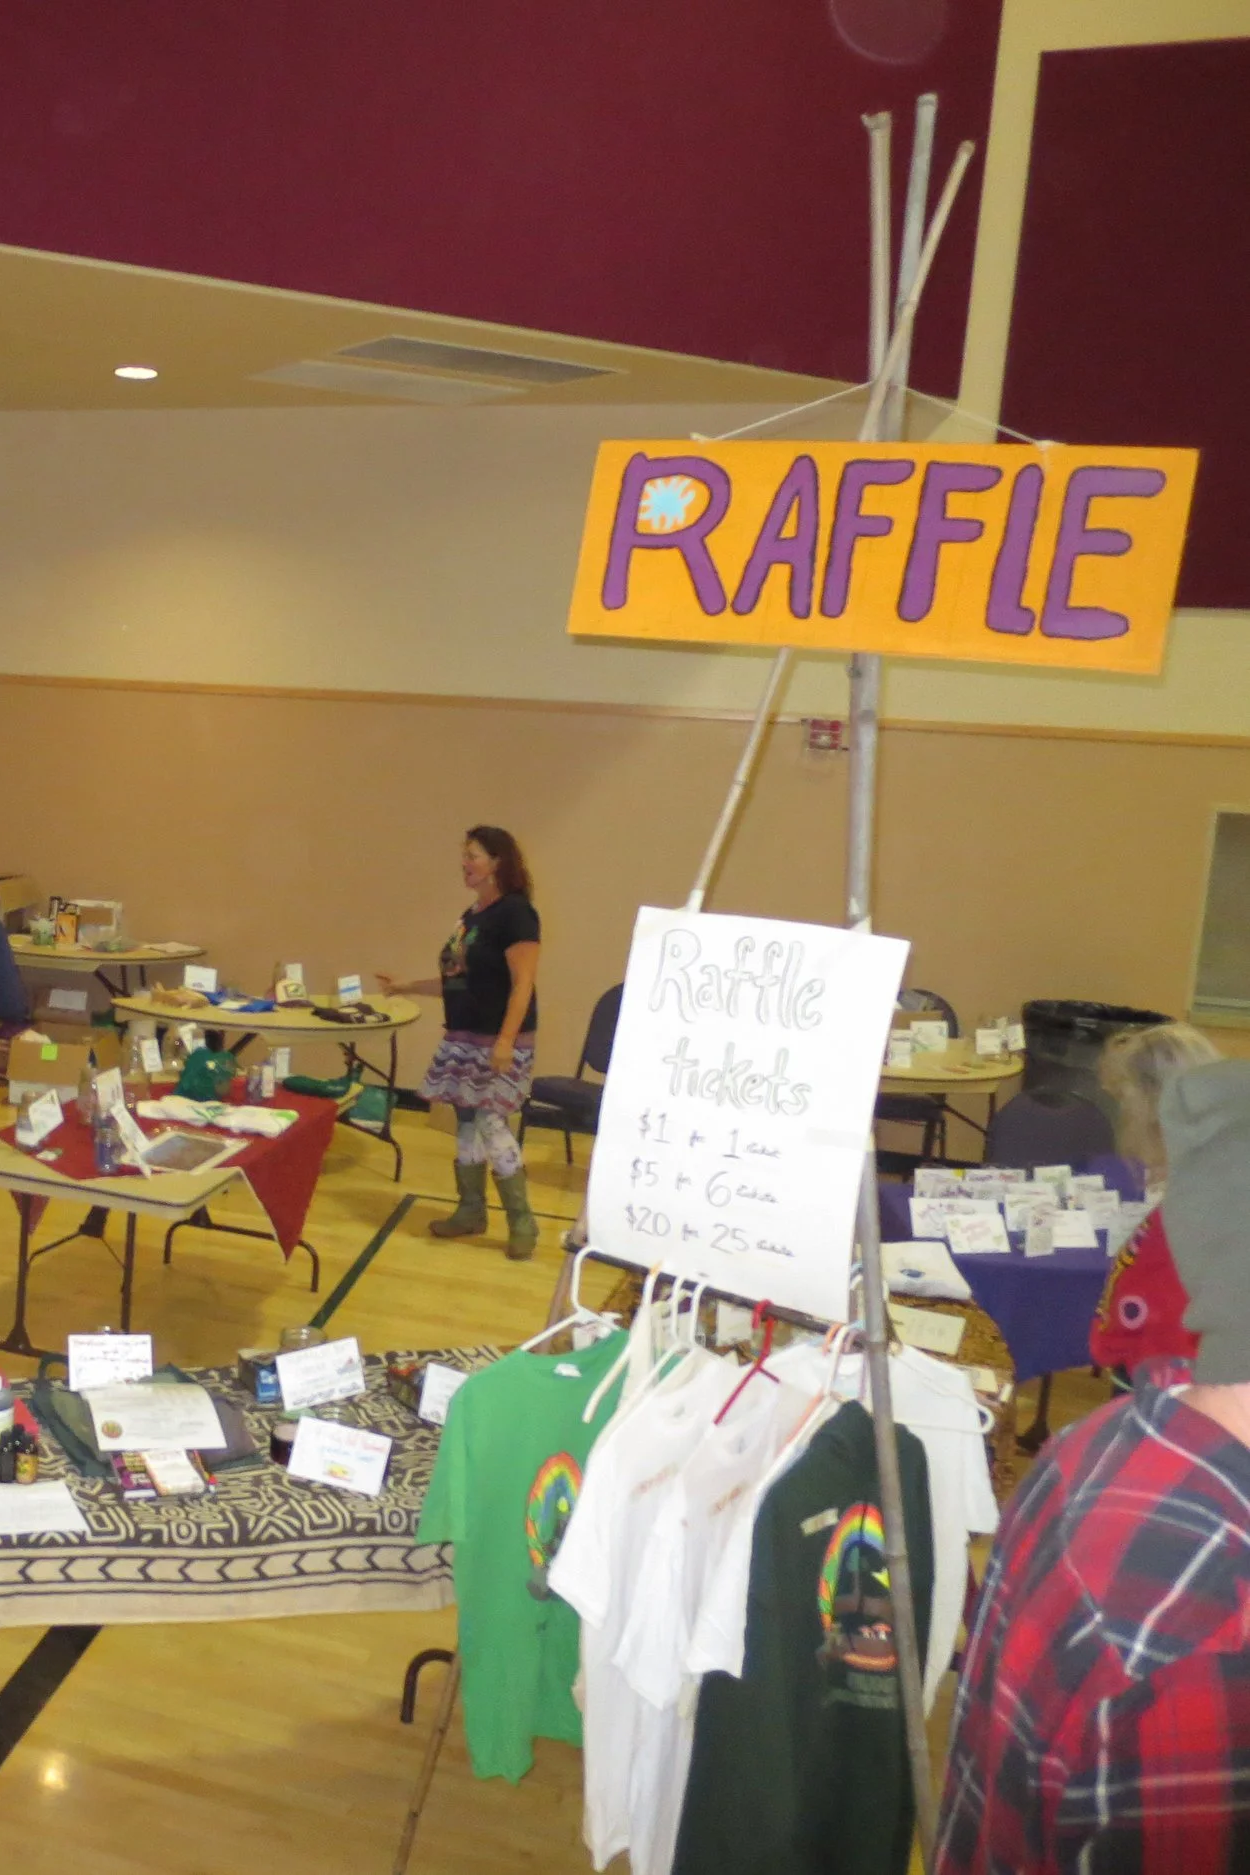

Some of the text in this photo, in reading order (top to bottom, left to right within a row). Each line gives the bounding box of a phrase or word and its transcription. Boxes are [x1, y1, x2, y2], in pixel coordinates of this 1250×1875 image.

[601, 452, 1167, 641] RAFFLE
[648, 929, 826, 1031] Raffle
[663, 1036, 812, 1116] tickets
[638, 1107, 671, 1144] $1
[722, 1128, 742, 1159] 1
[630, 1157, 659, 1188] $5
[705, 1170, 732, 1208] 6
[624, 1204, 671, 1238] $20
[710, 1222, 750, 1256] 25
